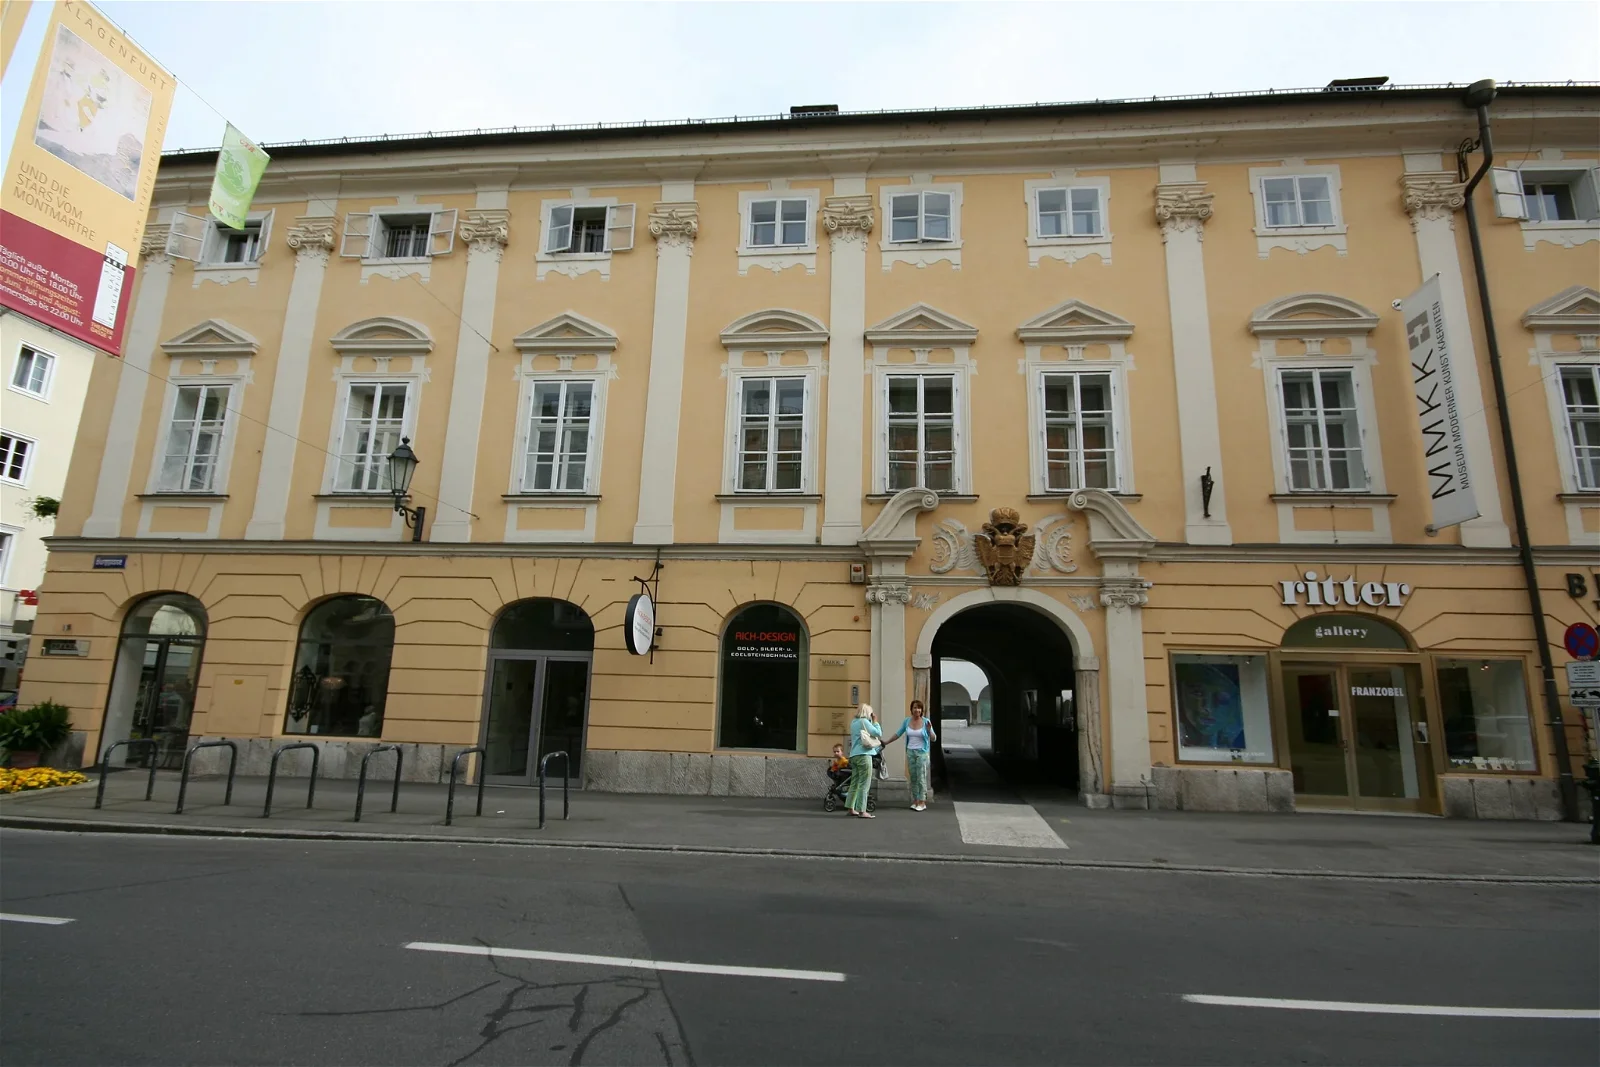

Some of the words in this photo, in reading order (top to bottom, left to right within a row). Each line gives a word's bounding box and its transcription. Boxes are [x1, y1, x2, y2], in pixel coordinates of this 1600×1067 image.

[64, 0, 167, 90] KLAGENFURT
[16, 174, 53, 203] STARS
[57, 202, 84, 222] VOM
[20, 162, 48, 184] UND
[50, 179, 71, 199] DIE
[13, 186, 96, 241] MONTMARTRE
[0, 264, 78, 307] ommeröffnungszeiten
[20, 265, 34, 277] Uhr
[35, 273, 47, 284] bis
[49, 279, 69, 295] 18.00
[24, 286, 37, 297] Juli
[39, 293, 53, 303] und
[27, 259, 49, 274] außer
[50, 270, 78, 291] Montag
[0, 284, 37, 306] onnerstags
[39, 301, 49, 312] bis
[50, 306, 70, 321] 22.00
[70, 316, 84, 327] Uhr
[1431, 300, 1447, 352] KAERNTEN
[1439, 352, 1452, 385] KUNST
[1412, 348, 1456, 500] MMKK
[1444, 387, 1463, 440] MODERNER
[1455, 443, 1469, 489] MUSEUM
[1279, 570, 1410, 608] ritter
[1315, 626, 1369, 639] gallery
[1351, 685, 1405, 697] FRANZOBEL
